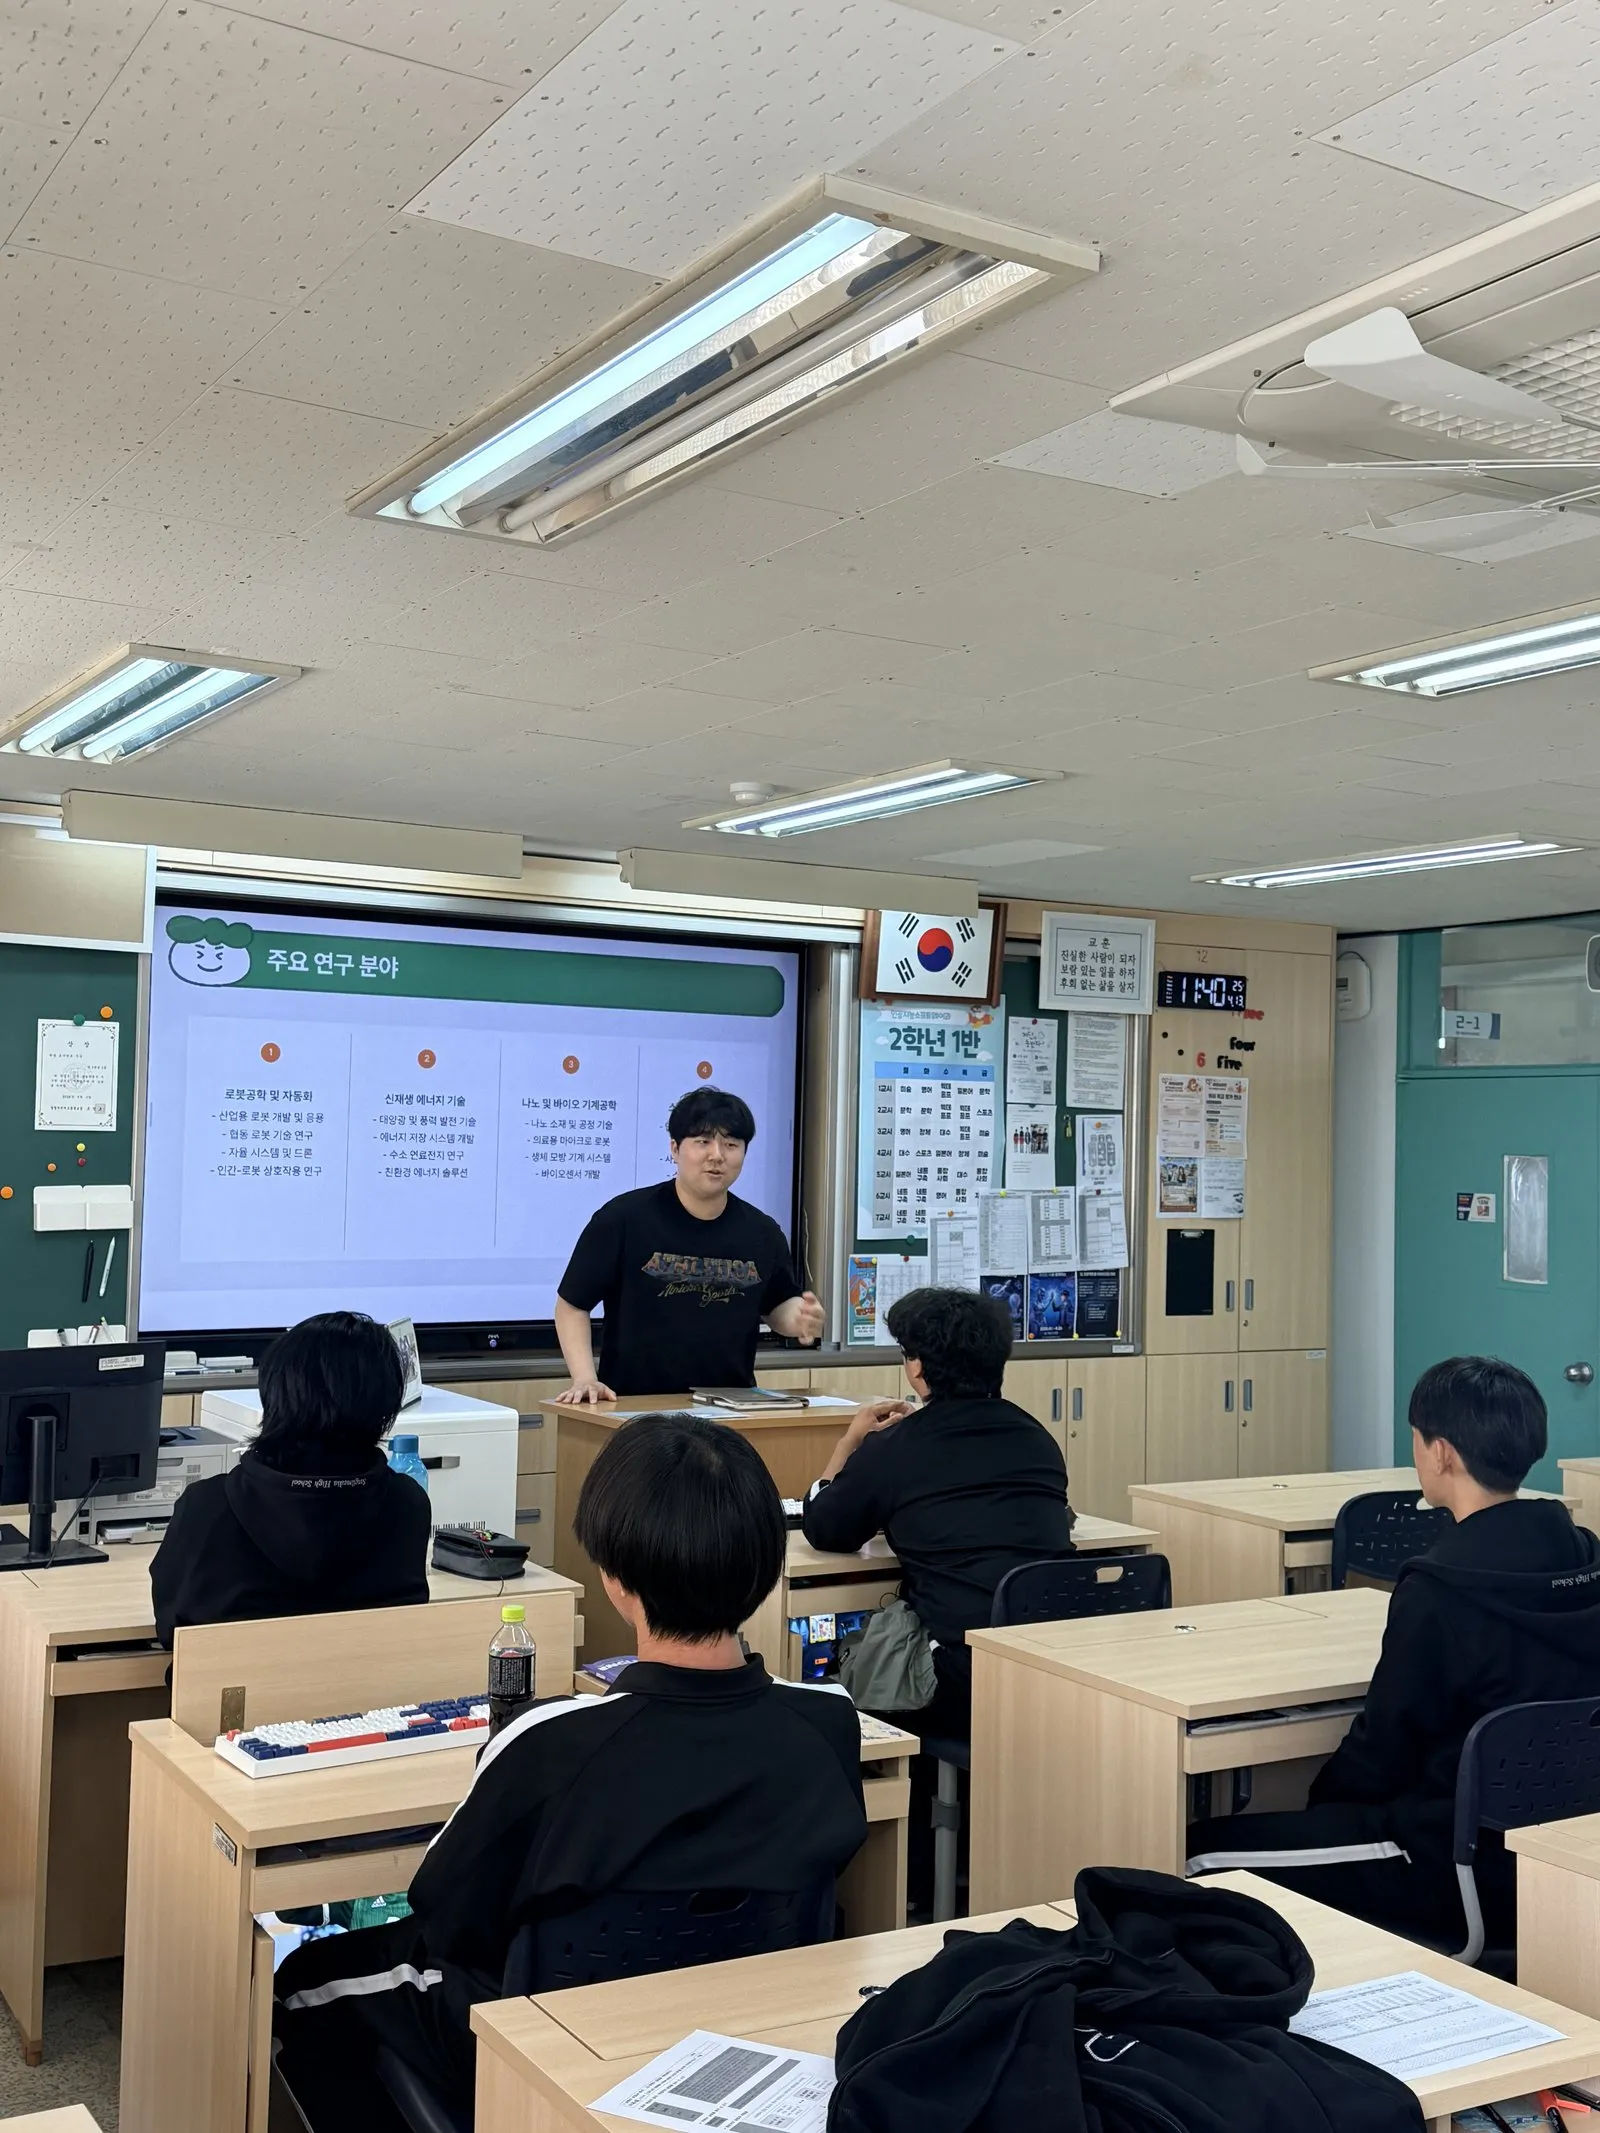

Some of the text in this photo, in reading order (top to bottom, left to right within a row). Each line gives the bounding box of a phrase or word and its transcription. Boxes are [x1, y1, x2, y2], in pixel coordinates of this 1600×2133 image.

[1088, 938, 1110, 949] 교 훈
[1061, 950, 1136, 966] 진실한 사람이 되자
[267, 949, 398, 979] 주요 연구 분야
[1061, 964, 1135, 979] 보람 있는 일을 하자
[1060, 978, 1135, 993] 후회 없는 삶을 살자
[1182, 977, 1226, 1006] 11:40
[1456, 1016, 1480, 1029] 2-1
[889, 1026, 981, 1058] 2학년 1반
[424, 1055, 429, 1063] 2
[569, 1060, 574, 1068] 3
[1197, 1052, 1242, 1070] 6 Five
[225, 1089, 312, 1102] 로봇공학 및 자동화
[385, 1094, 466, 1107] 신재생 에너지 기술
[522, 1098, 616, 1111] 나노 및 바이오 기계공학
[219, 1111, 324, 1123] 산업용 로봇 개발 및 응용
[380, 1115, 476, 1127] 태양광 및 풍력 발전 기술
[531, 1119, 612, 1130] 나노 소재 및 공정 기술
[230, 1129, 313, 1141] 협동 로봇 기술 연구
[380, 1133, 474, 1144] 에너지 저장 시스템 개발
[533, 1136, 610, 1146] 의료용 마이크로 로봇
[229, 1148, 312, 1159] 자율 시스템 및 드론
[390, 1150, 463, 1160] 수소 연료전지 연구
[532, 1152, 611, 1163] 생체 모방 기계 시스템
[218, 1166, 321, 1176] 인간-로봇 상호작용 연구
[385, 1167, 467, 1178] 친환경 에너지 솔루션
[542, 1169, 600, 1179] 바이오센서 개발
[292, 1479, 312, 1488] School
[314, 1478, 332, 1488] High
[1552, 1578, 1573, 1588] School
[1575, 1574, 1590, 1584] High
